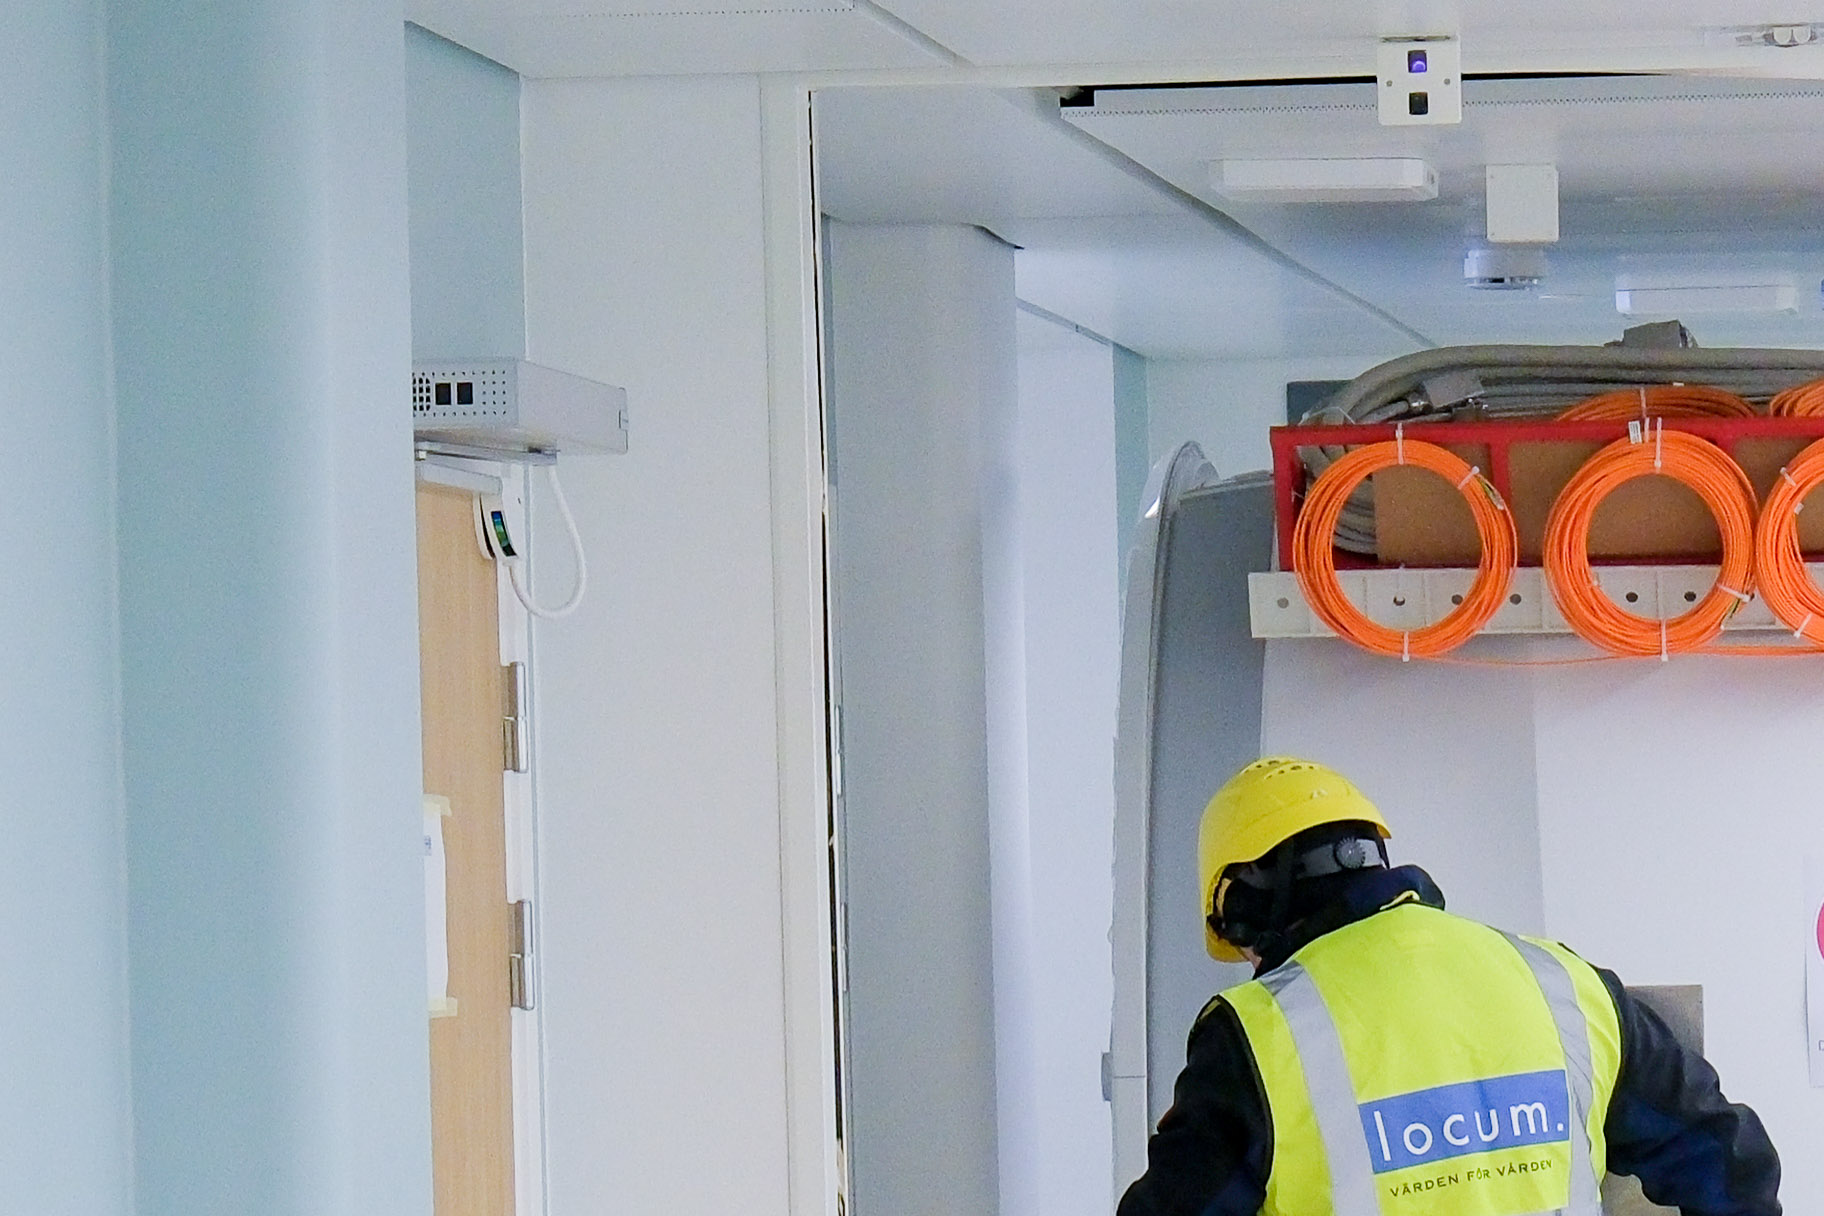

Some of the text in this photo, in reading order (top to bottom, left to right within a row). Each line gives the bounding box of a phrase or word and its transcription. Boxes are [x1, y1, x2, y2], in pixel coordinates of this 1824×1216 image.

[1373, 1102, 1564, 1161] locum.
[1467, 1167, 1491, 1182] FÖR
[1496, 1159, 1553, 1177] VÅRDEN
